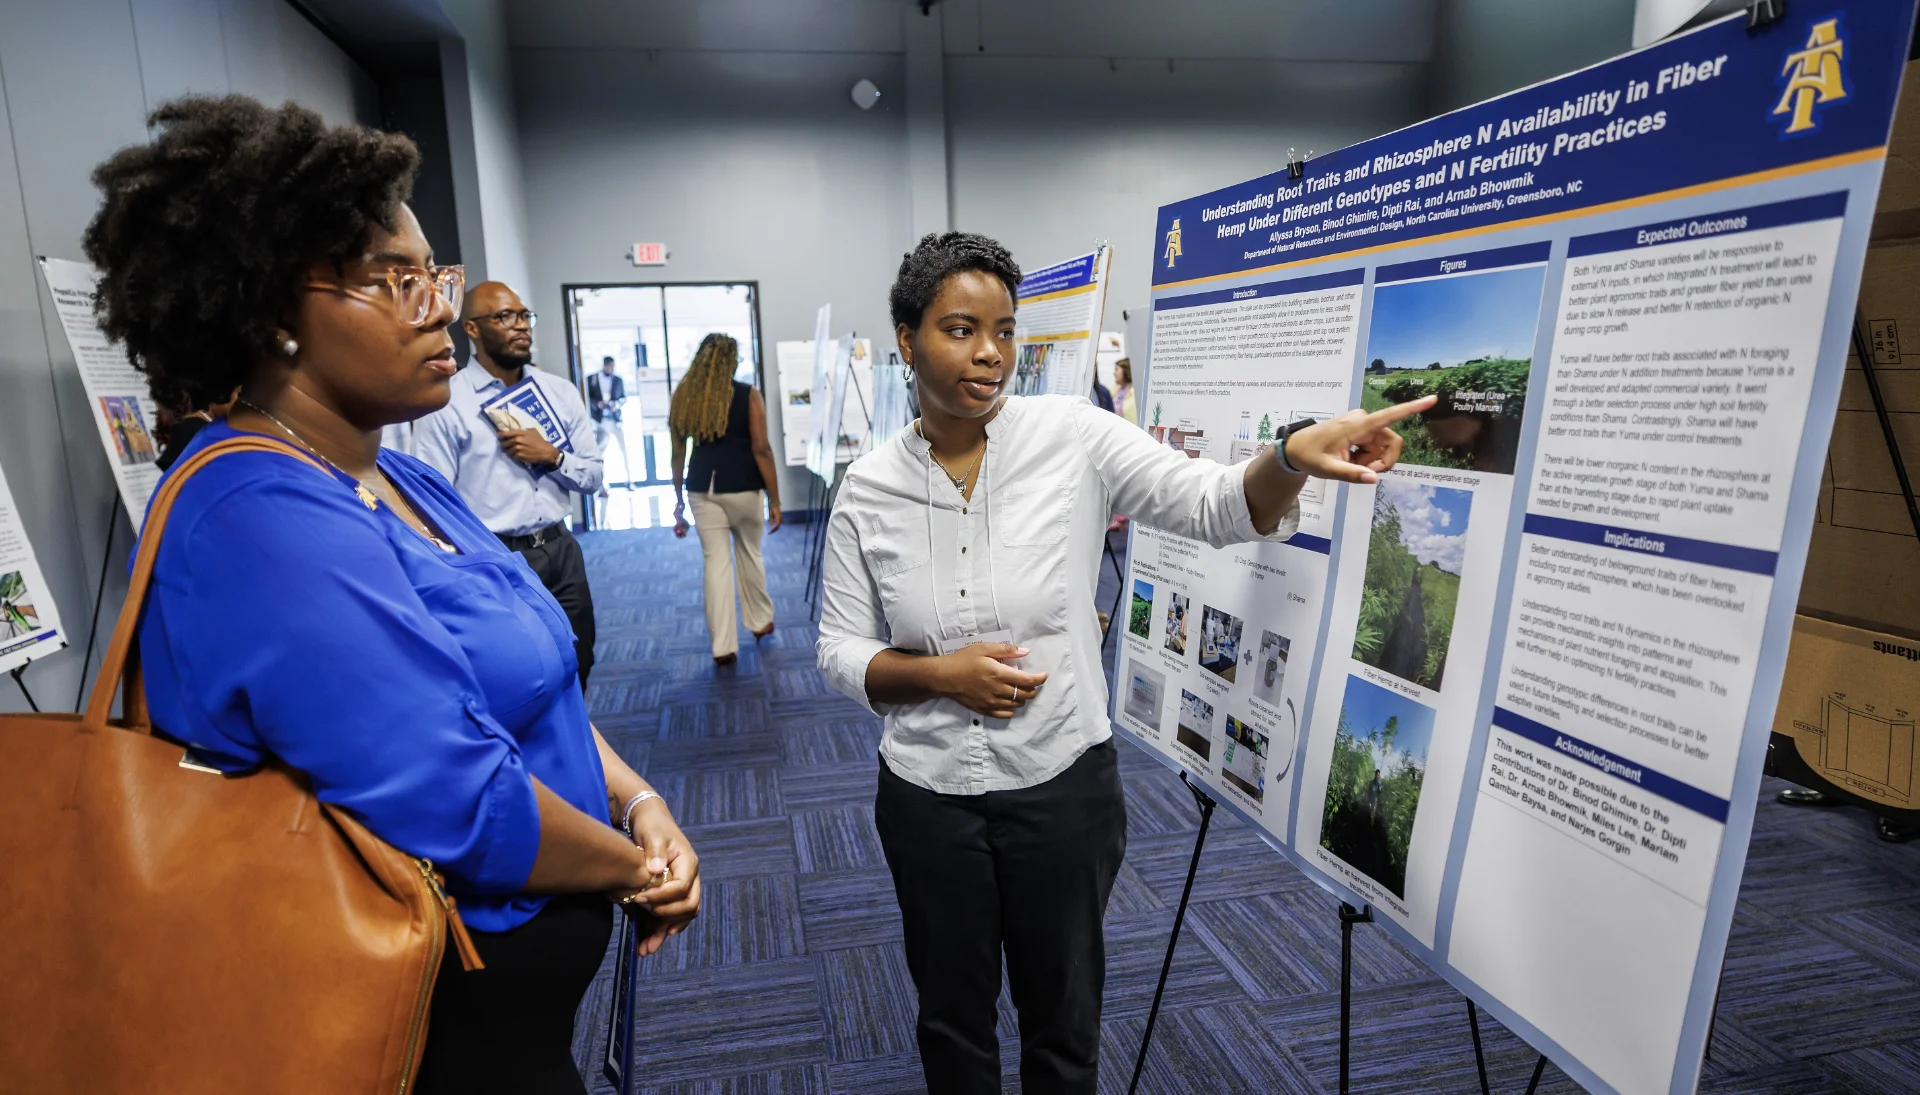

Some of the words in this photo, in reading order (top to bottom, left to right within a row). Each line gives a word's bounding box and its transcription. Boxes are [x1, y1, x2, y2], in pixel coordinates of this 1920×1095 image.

[1202, 193, 1274, 221] Understanding
[1276, 181, 1303, 202] Root
[1305, 171, 1340, 193] Traits
[1343, 159, 1370, 182] and
[1372, 134, 1471, 173] Rhizosphere
[1476, 123, 1492, 145] N
[1496, 90, 1620, 139] Availability
[1625, 79, 1649, 103] in
[1656, 55, 1727, 93] Fiber
[1216, 222, 1246, 238] Hemp
[1248, 212, 1280, 231] Under
[1282, 196, 1333, 222] Different
[1335, 178, 1410, 208] Genotypes
[1414, 164, 1446, 189] and
[1449, 159, 1465, 181] N
[1469, 142, 1547, 176] Fertility
[1553, 111, 1666, 155] Practices
[1293, 224, 1320, 238] Bryson,
[1321, 215, 1344, 230] Binod
[1345, 209, 1379, 225] Ghimire,
[1381, 201, 1402, 218] Dipti
[1403, 197, 1421, 212] Rai,
[1423, 191, 1444, 208] and
[1444, 184, 1477, 203] Arnab
[1479, 171, 1534, 195] Bhowmik
[1243, 247, 1271, 259] Department
[1270, 240, 1278, 254] of
[1276, 240, 1295, 252] Natural
[1294, 236, 1323, 248] Resources
[1323, 232, 1335, 243] and
[1335, 223, 1379, 240] Environmental
[1379, 219, 1404, 231] Design,
[1405, 213, 1426, 226] North
[1427, 207, 1459, 221] Carolina
[1460, 198, 1504, 215] University,
[1506, 186, 1564, 205] Greensboro,
[1565, 179, 1583, 193] NC
[1636, 223, 1686, 244] Expected
[1687, 216, 1748, 237] Outcomes
[639, 244, 661, 262] EXIT
[1572, 265, 1590, 277] Both
[1591, 264, 1612, 274] Yuma
[1612, 260, 1628, 272] and
[1628, 258, 1656, 270] Shama
[1657, 253, 1691, 266] varieties
[1692, 249, 1707, 261] will
[1707, 248, 1720, 260] be
[1721, 243, 1772, 257] responsive
[1773, 240, 1784, 251] to
[1439, 258, 1466, 273] Figures
[1232, 288, 1257, 299] Introduction
[1885, 325, 1895, 338] cm
[1875, 342, 1884, 351] 36
[1887, 341, 1897, 360] 91.4
[1369, 377, 1387, 386] Control
[1410, 377, 1424, 386] Urea
[1453, 402, 1474, 413] Poultry
[1474, 403, 1503, 413] Manure)
[1454, 390, 1486, 402] Integrated
[1486, 391, 1506, 402] (Urea
[1413, 471, 1430, 480] active
[1431, 473, 1461, 483] vegetative
[1463, 476, 1481, 487] stage
[1536, 497, 1561, 508] needed
[1561, 498, 1571, 509] for
[1571, 502, 1595, 512] growth
[1595, 505, 1610, 515] and
[1603, 530, 1665, 552] Implications
[1530, 542, 1551, 555] Better
[1551, 548, 1598, 567] understanding
[1607, 559, 1656, 576] belowground
[1656, 568, 1677, 581] traits
[1689, 573, 1708, 586] fiber
[1873, 640, 1920, 662] ttants
[1363, 668, 1378, 681] Fiber
[1376, 675, 1392, 687] Hemp
[1392, 681, 1399, 689] at
[1399, 683, 1420, 697] harvest
[1554, 736, 1641, 782] Acknowledgement
[1496, 737, 1512, 752] This
[1514, 747, 1533, 761] work
[1535, 757, 1552, 770] was
[1553, 765, 1577, 781] made
[1578, 776, 1617, 800] possible
[1618, 794, 1637, 809] due
[1639, 803, 1650, 815] to
[1652, 809, 1669, 824] the
[1493, 752, 1545, 782] contributions
[1546, 777, 1557, 786] of
[1557, 779, 1569, 792] Dr.
[1571, 786, 1599, 807] Binod
[1642, 820, 1658, 835] Dr.
[1660, 828, 1686, 849] Dipti
[1488, 776, 1520, 797] Qambar
[1520, 791, 1548, 813] Baysa,
[1549, 808, 1567, 822] and
[1567, 815, 1596, 837] Narjes
[1597, 831, 1630, 855] Gorgin
[1490, 763, 1505, 778] Rai,
[1507, 771, 1519, 782] Dr.
[1520, 778, 1546, 797] Arnab
[1547, 790, 1588, 818] Bhowmik,
[1591, 811, 1615, 831] Miles
[1617, 825, 1637, 843] Lee,
[1640, 836, 1678, 862] Mariam
[1315, 848, 1328, 862] Fiber
[1328, 857, 1343, 873] Hemp
[1343, 868, 1350, 877] at
[1350, 871, 1371, 889] harvest
[1370, 884, 1384, 898] from
[1384, 895, 1409, 918] integrated
[1349, 880, 1375, 903] treatment
